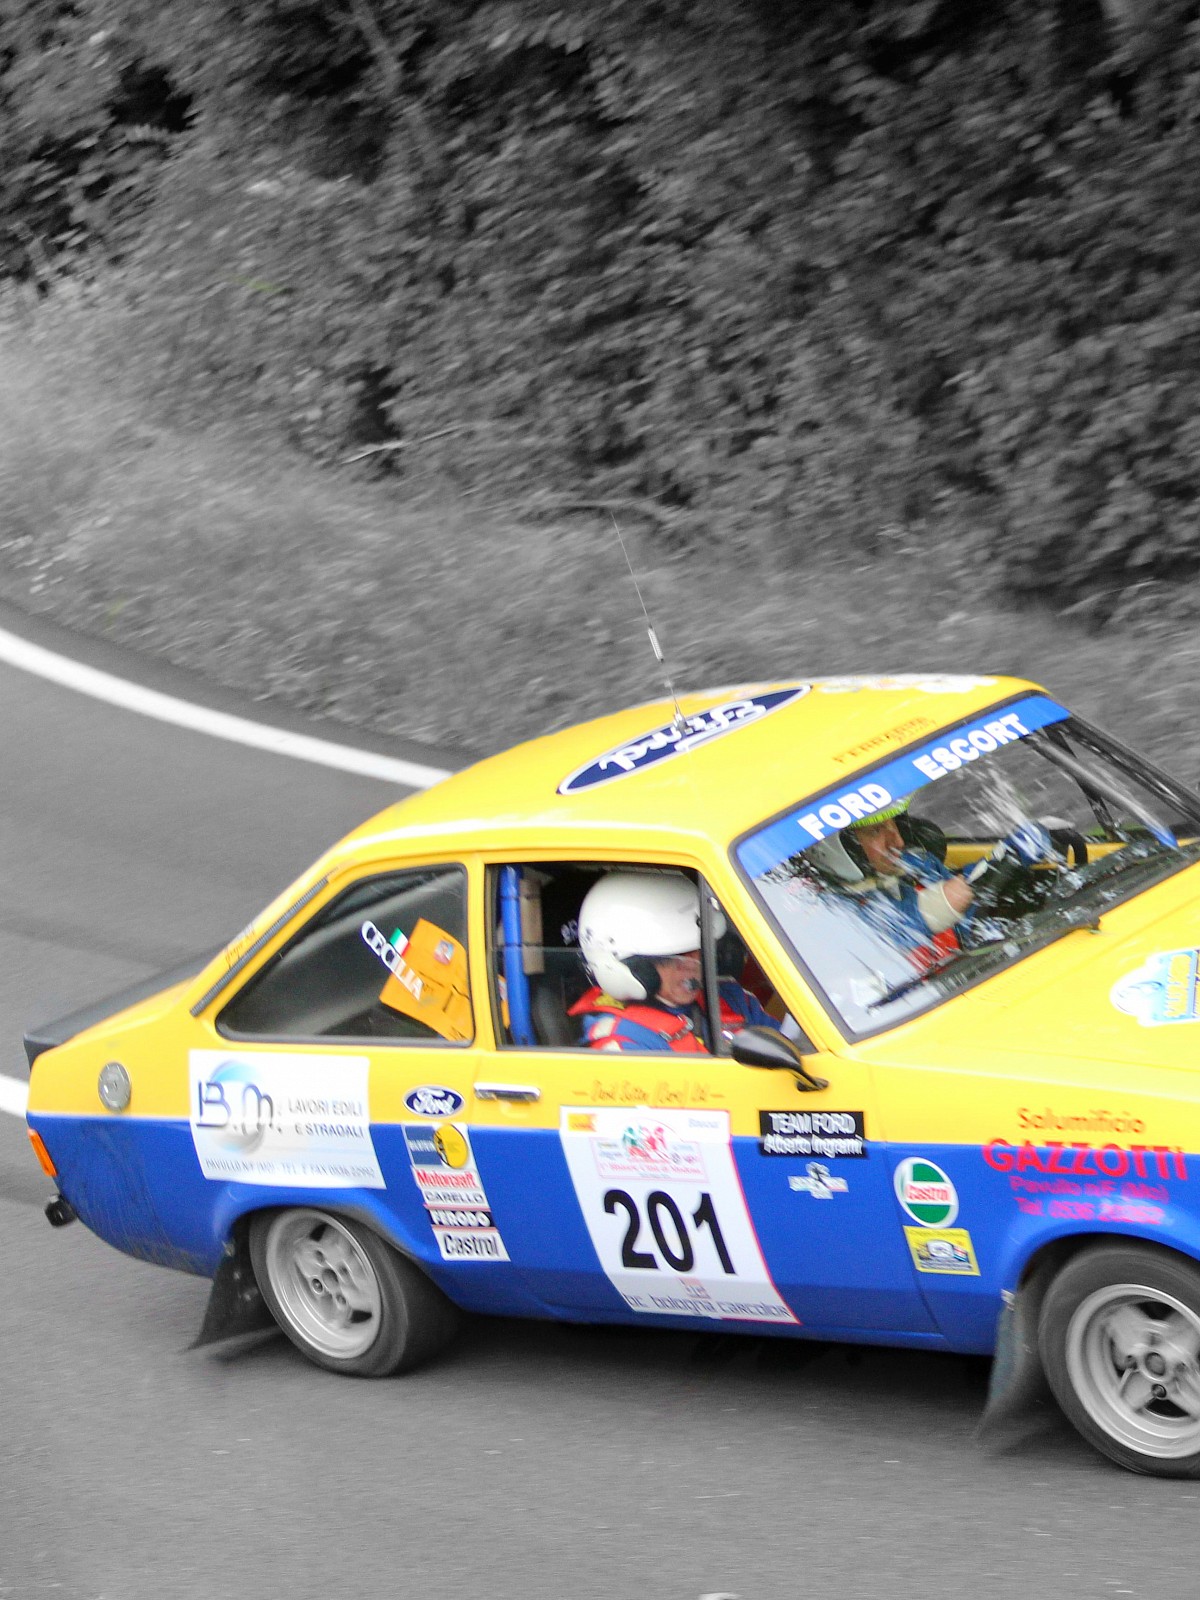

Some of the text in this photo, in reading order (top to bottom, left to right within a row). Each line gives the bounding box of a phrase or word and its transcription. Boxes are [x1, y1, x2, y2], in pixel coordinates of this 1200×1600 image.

[797, 712, 1029, 841] FORD ESCORT
[412, 1087, 455, 1115] Ford
[306, 1122, 364, 1139] STRADALI
[769, 1113, 856, 1135] TEAM FORD
[1018, 1108, 1146, 1134] Salumificio
[982, 1138, 1188, 1181] GAZZOTTI
[416, 1169, 477, 1188] Motorcraft
[1009, 1176, 1082, 1195] Pavullo
[603, 1189, 736, 1275] 201
[443, 1233, 500, 1256] Castrol
